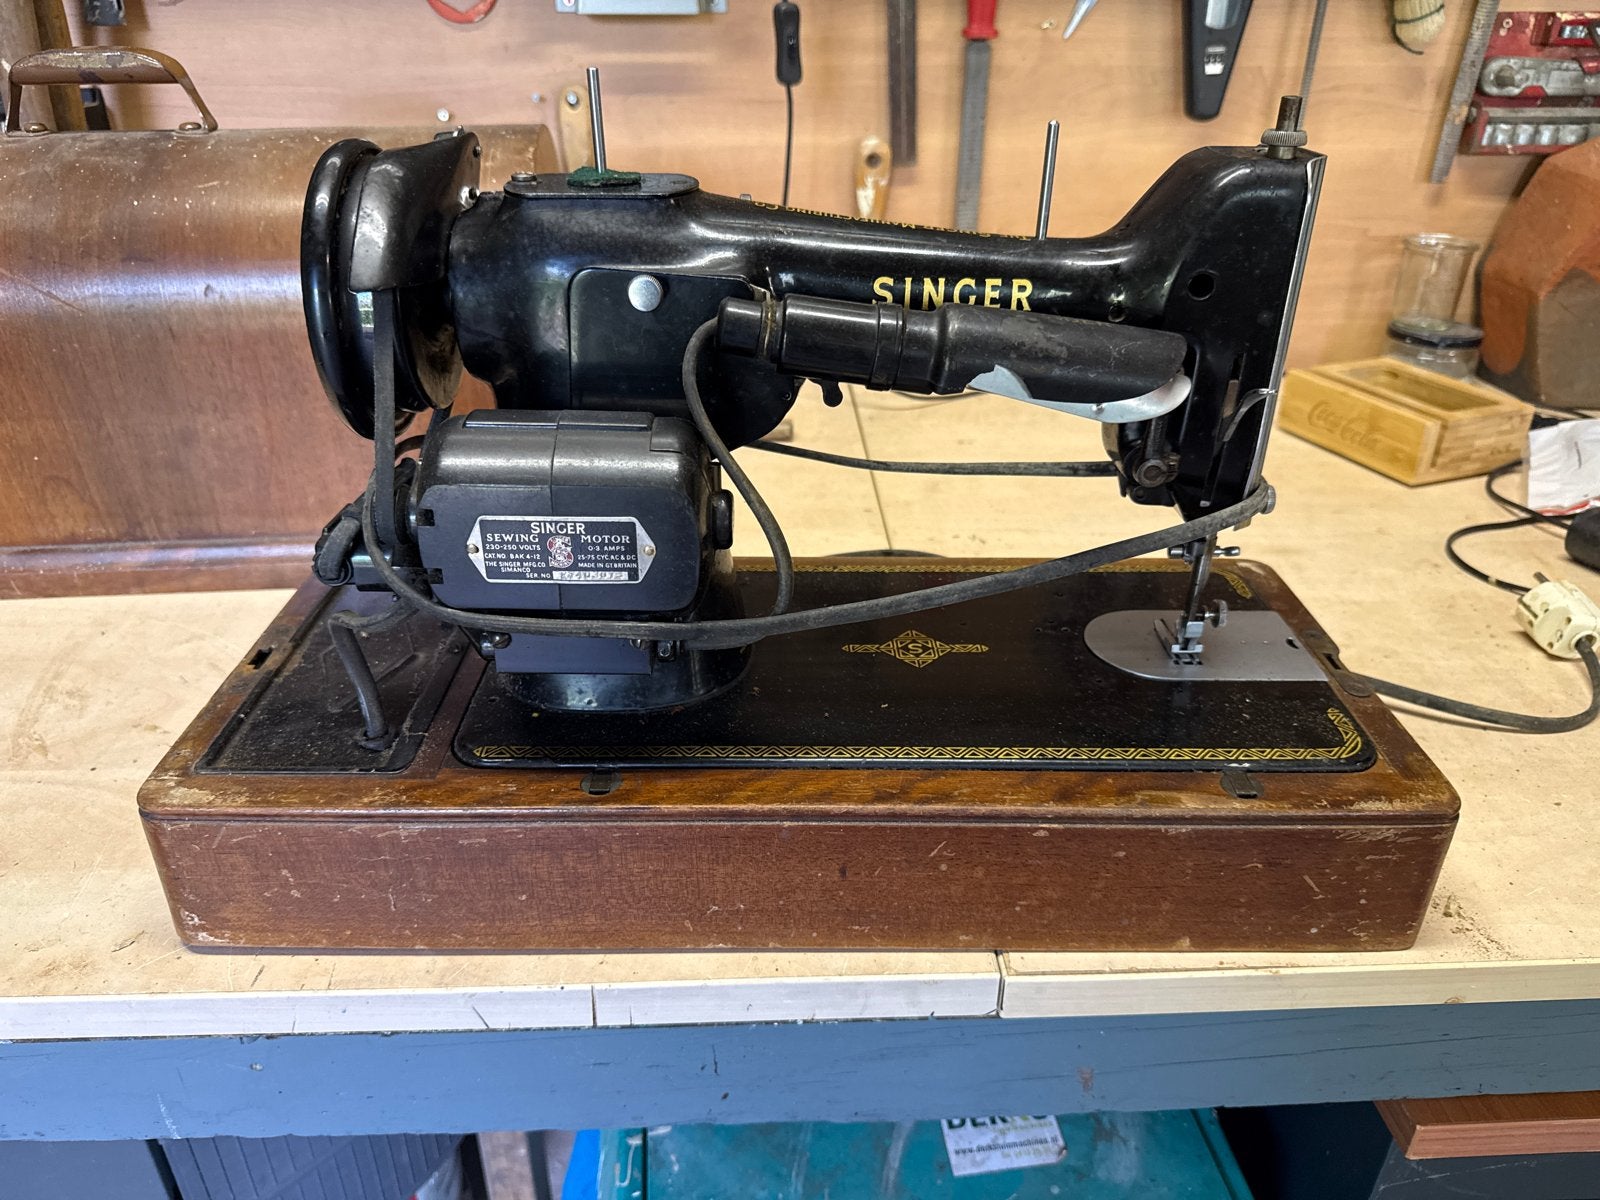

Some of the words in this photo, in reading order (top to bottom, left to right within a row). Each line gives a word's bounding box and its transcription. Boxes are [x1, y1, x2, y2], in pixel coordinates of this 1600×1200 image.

[873, 276, 1033, 311] SINGER
[530, 521, 586, 534] SINGER
[486, 533, 539, 543] SEWING
[580, 534, 631, 544] MOTOR
[485, 543, 517, 551] 230-250
